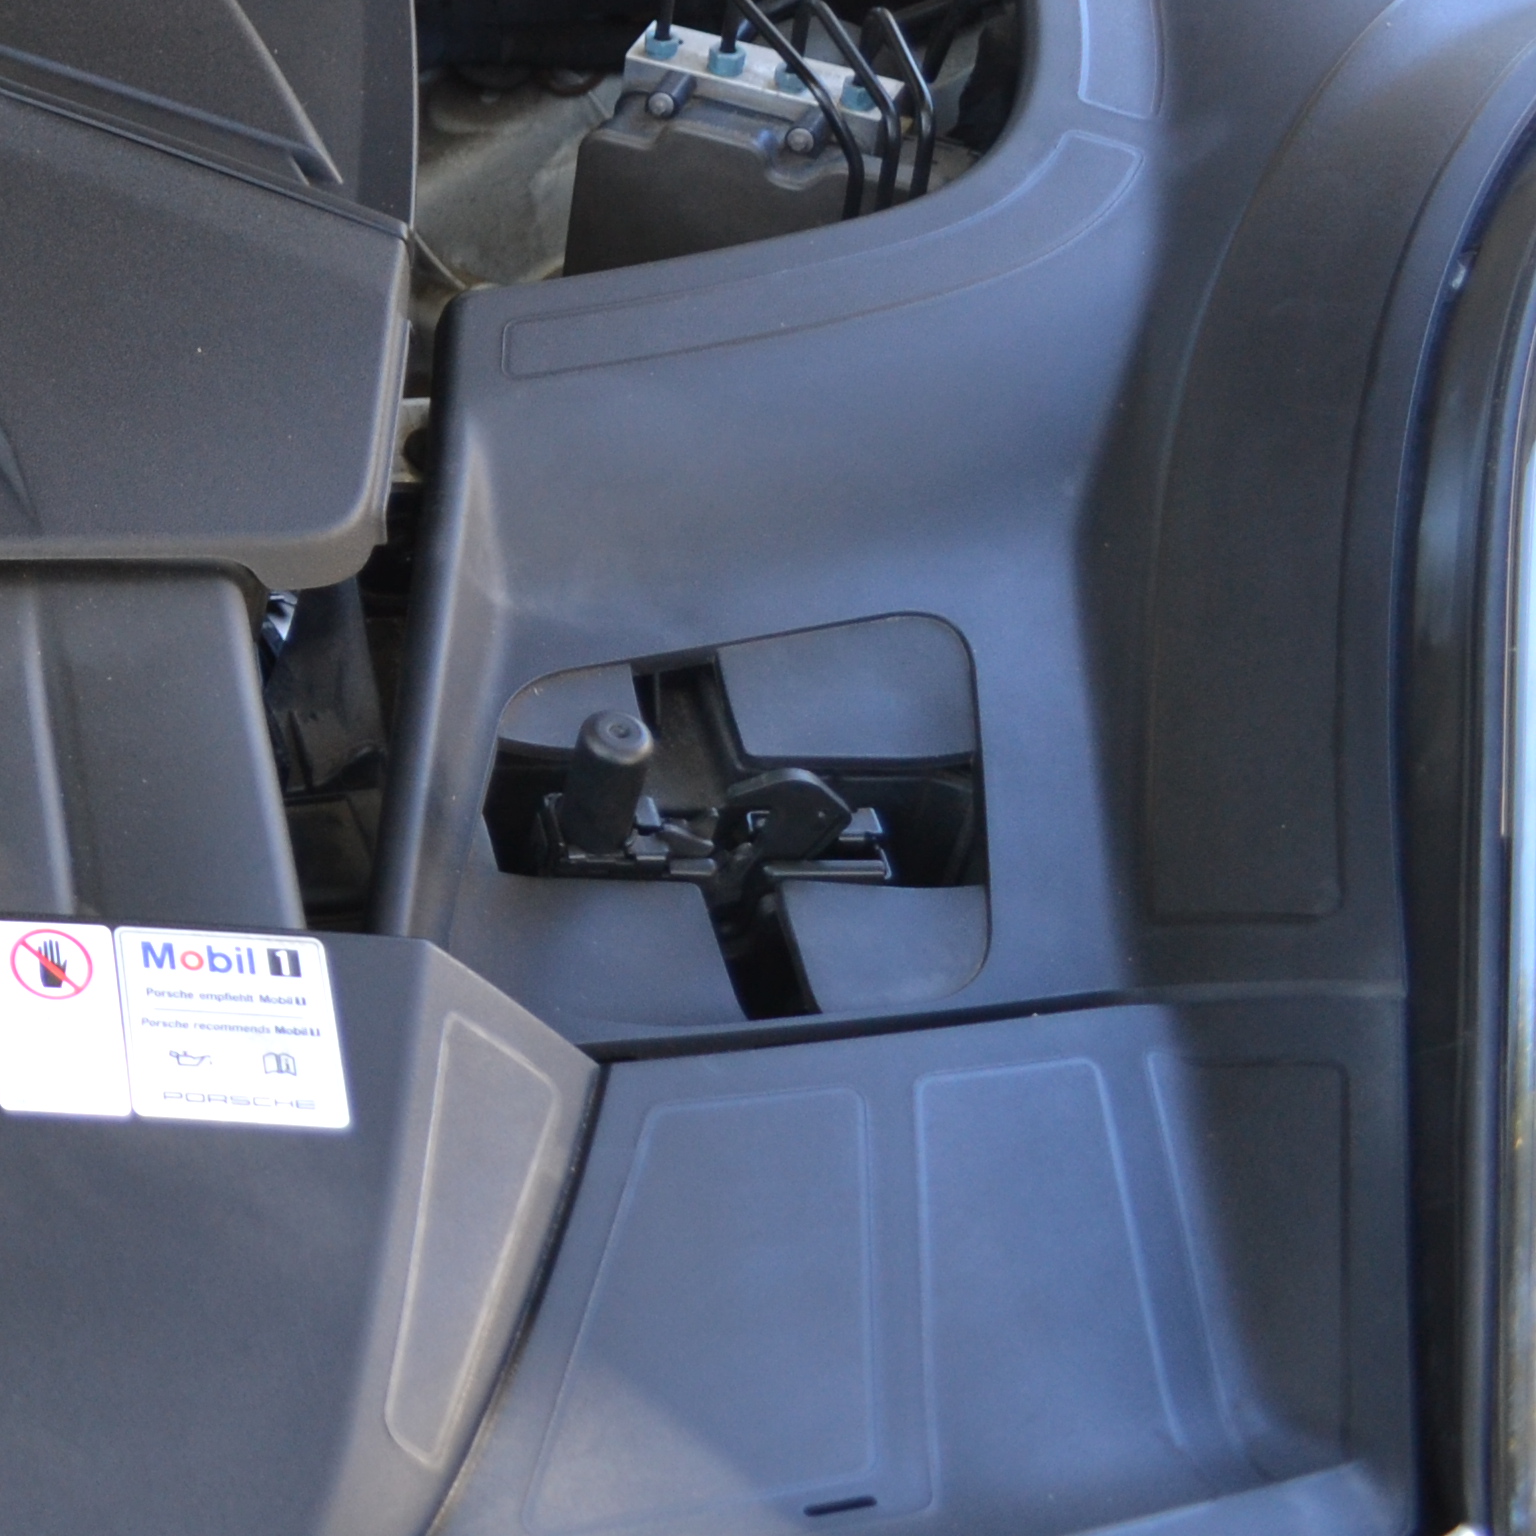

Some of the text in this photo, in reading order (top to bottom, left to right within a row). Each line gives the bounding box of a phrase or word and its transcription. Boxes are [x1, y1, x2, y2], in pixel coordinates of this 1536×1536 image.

[141, 941, 302, 977] Mobil 1
[146, 987, 194, 1000] Porsche
[141, 1017, 189, 1029] Porsche
[194, 1022, 271, 1034] recommends
[163, 1091, 316, 1110] PORSCHE
